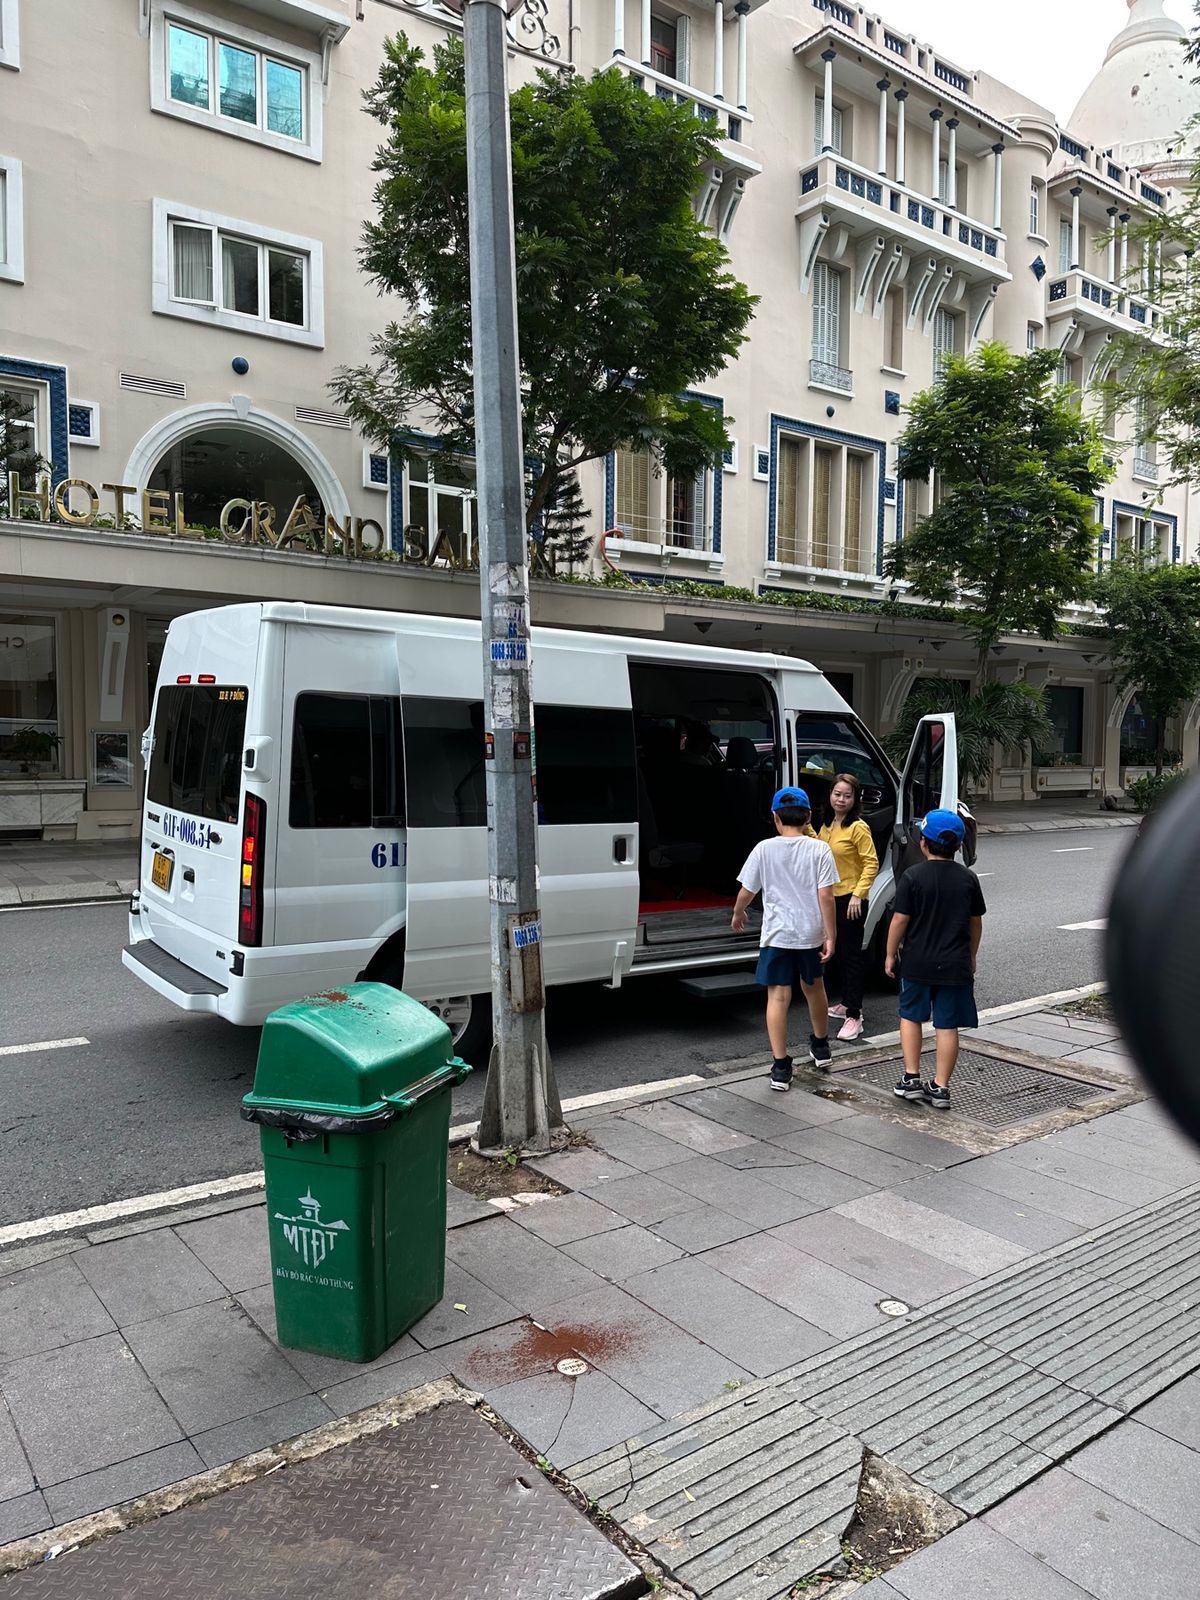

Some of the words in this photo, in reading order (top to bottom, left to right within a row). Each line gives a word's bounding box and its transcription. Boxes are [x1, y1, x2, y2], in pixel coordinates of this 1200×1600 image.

[9, 470, 205, 539] HOTEL
[219, 494, 385, 557] GRAND
[402, 524, 557, 579] SAIN
[283, 1223, 338, 1269] MTĐT
